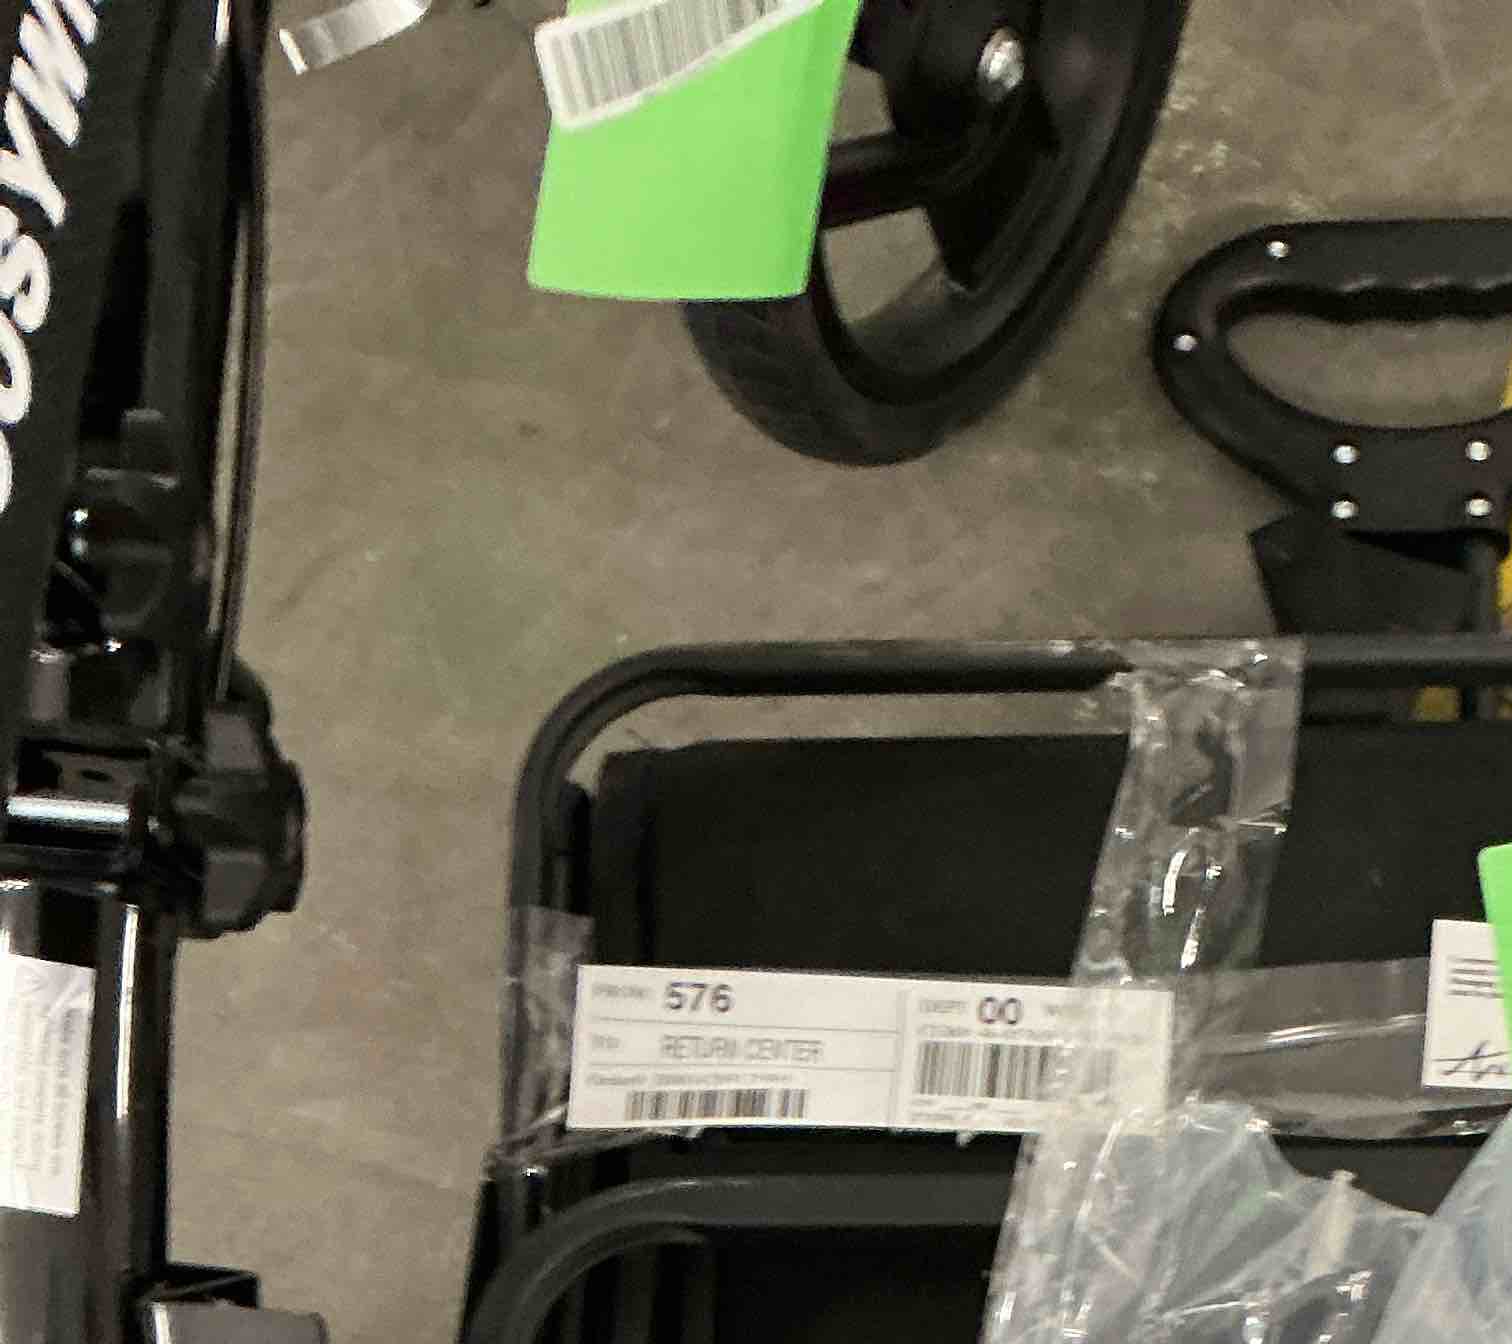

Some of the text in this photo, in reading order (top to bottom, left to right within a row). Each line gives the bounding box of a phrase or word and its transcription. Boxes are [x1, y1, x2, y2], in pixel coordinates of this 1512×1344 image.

[663, 981, 735, 1013] 576
[974, 996, 1024, 1024] 00
[659, 1034, 825, 1064] RETURN CENTER
